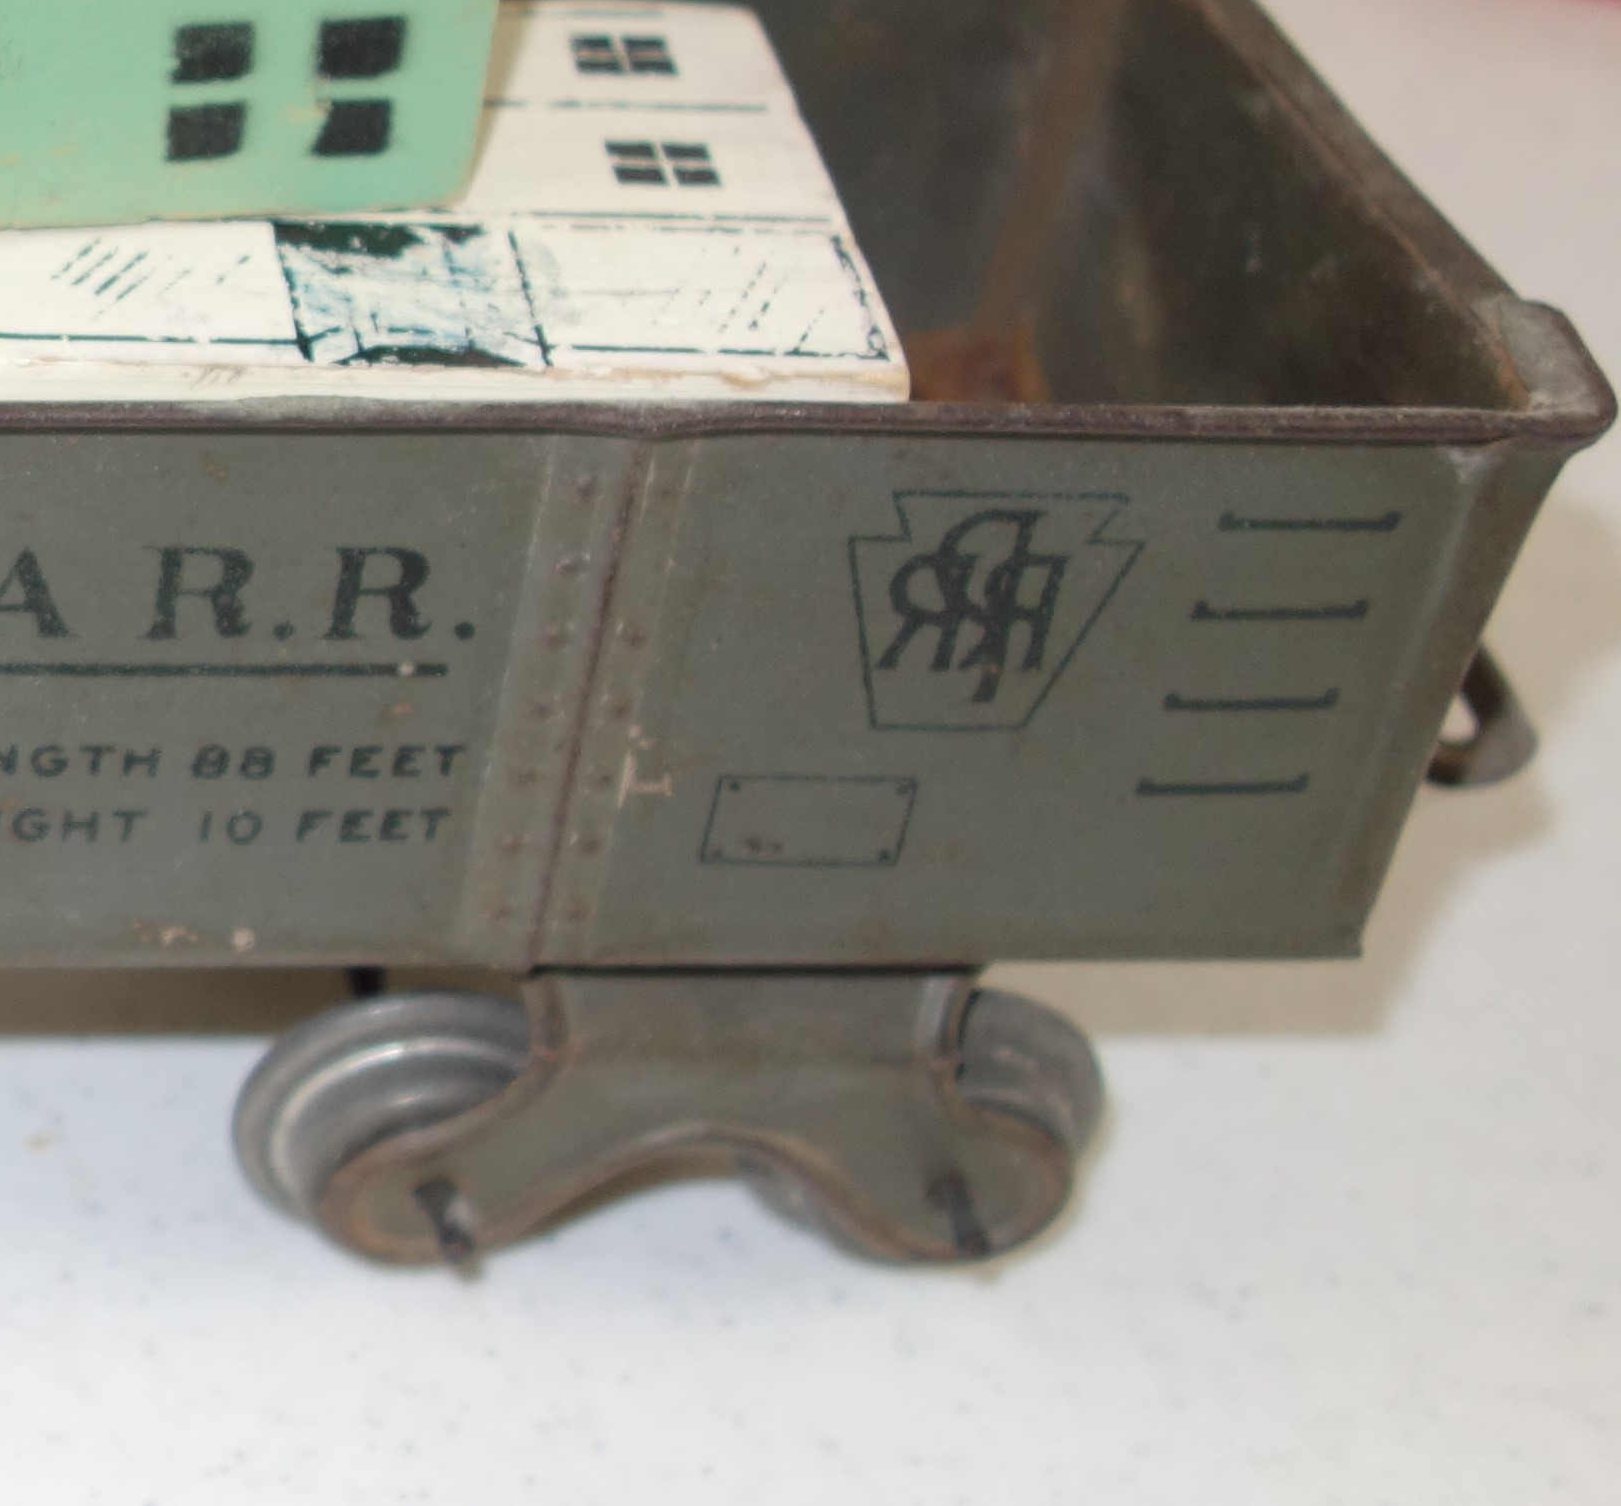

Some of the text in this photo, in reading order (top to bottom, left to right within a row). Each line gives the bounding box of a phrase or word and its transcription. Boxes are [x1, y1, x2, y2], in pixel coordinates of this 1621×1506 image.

[190, 744, 276, 780] 88
[308, 742, 469, 780] FEET
[199, 809, 264, 844] 10
[295, 807, 453, 844] FEET
